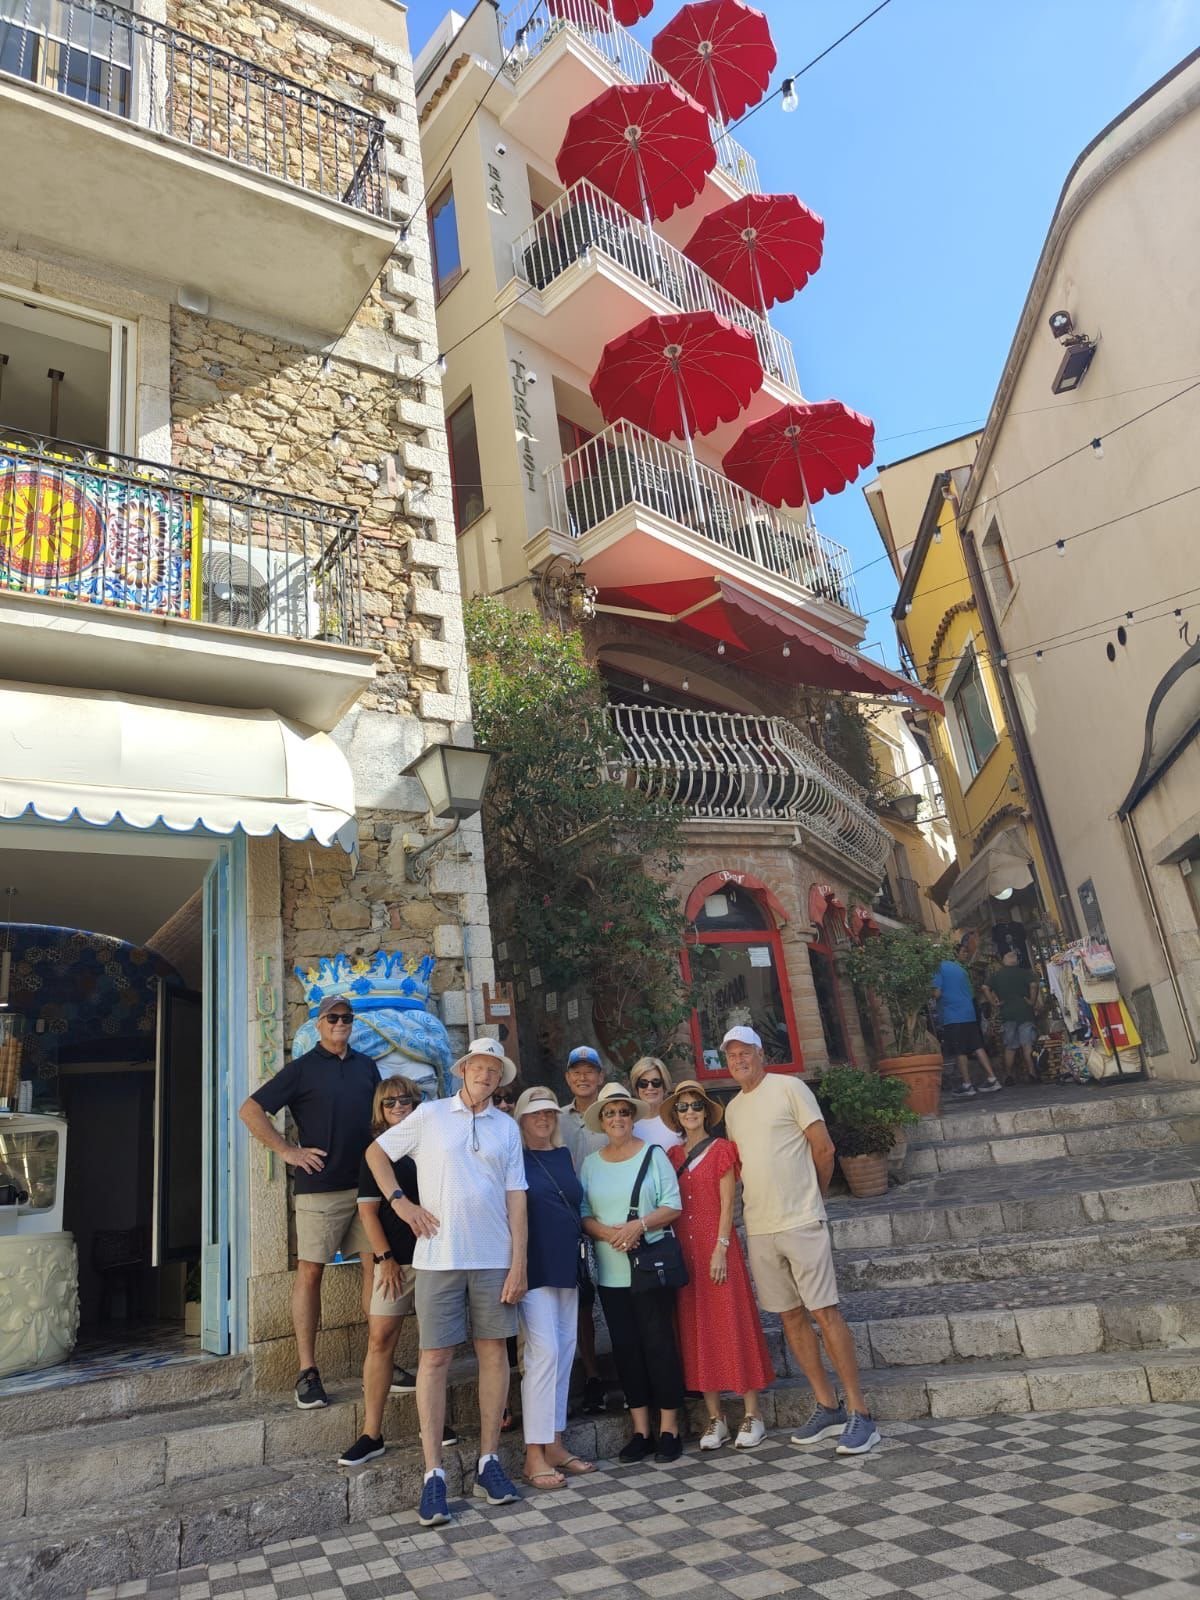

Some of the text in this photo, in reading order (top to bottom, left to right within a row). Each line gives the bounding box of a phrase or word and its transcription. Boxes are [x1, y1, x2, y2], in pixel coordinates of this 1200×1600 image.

[487, 162, 507, 216] BAR
[510, 359, 536, 492] TURRISI
[719, 870, 745, 884] Bar
[256, 953, 280, 1182] TURRI
